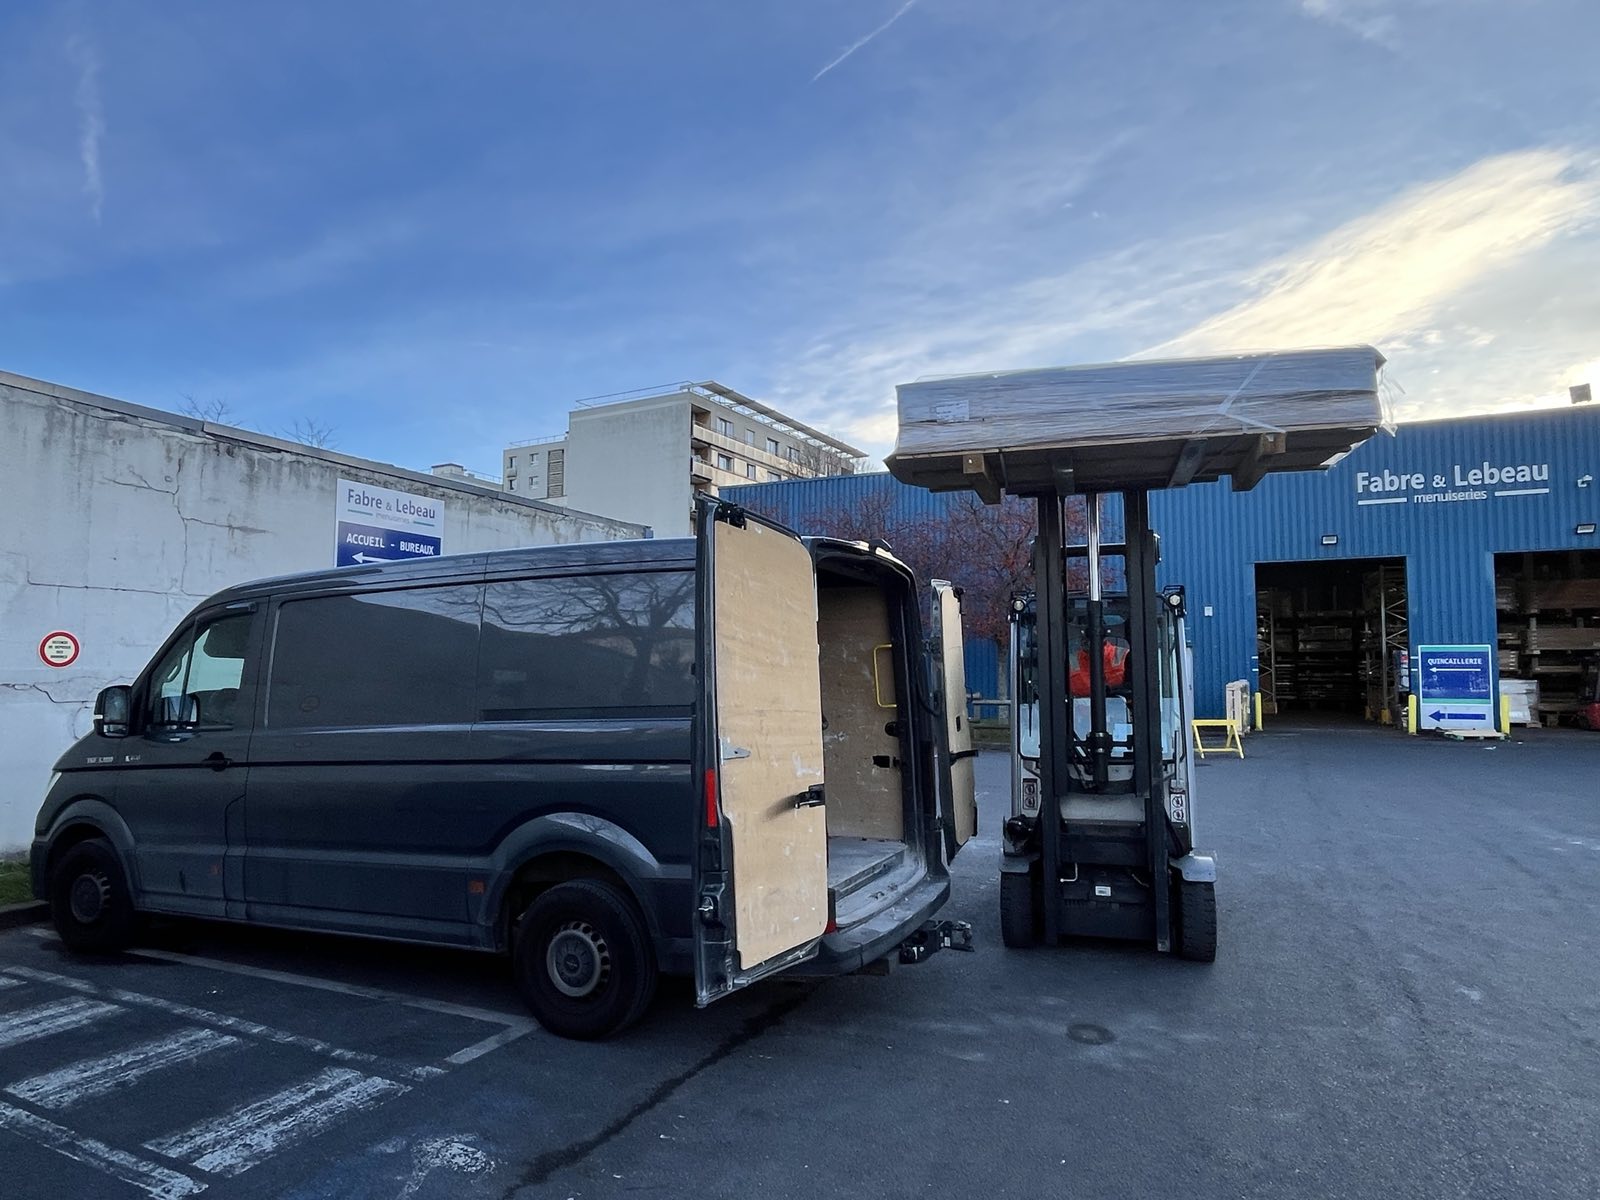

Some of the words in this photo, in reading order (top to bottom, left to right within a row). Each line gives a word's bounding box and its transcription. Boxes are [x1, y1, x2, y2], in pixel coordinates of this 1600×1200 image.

[1356, 469, 1425, 493] Fabre
[1432, 474, 1447, 488] &
[1454, 461, 1549, 487] Lebeau
[347, 488, 382, 509] Fabre
[385, 502, 393, 511] &
[396, 498, 436, 519] Lebeau
[1414, 489, 1488, 503] menuiseries
[346, 533, 385, 549] ACCUEIL
[400, 541, 435, 556] BUREAUX
[1427, 657, 1483, 666] QUINCAILLERIE
